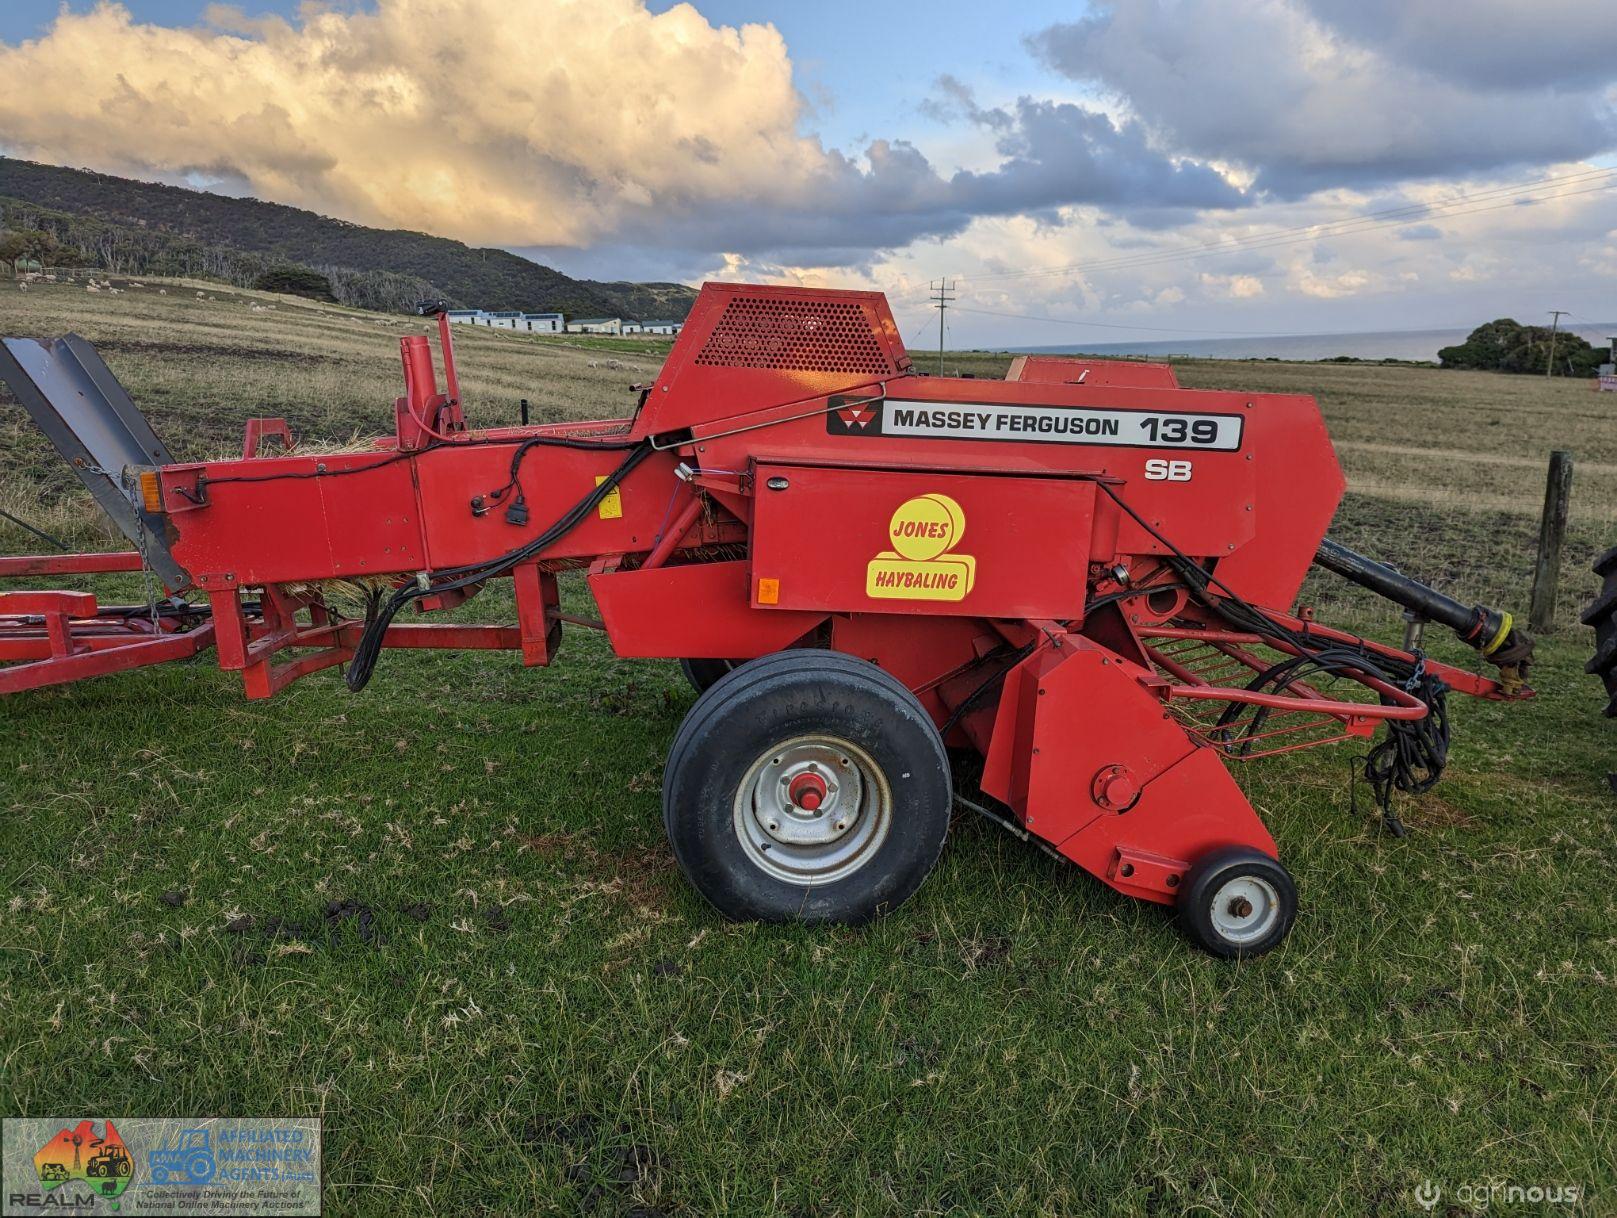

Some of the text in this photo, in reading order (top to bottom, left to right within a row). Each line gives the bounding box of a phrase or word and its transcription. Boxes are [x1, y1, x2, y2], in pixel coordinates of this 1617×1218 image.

[893, 409, 1218, 444] MASSEY FERGUSON 139
[1144, 459, 1192, 482] SB
[893, 521, 950, 539] JONES
[875, 571, 959, 590] HAYBALING
